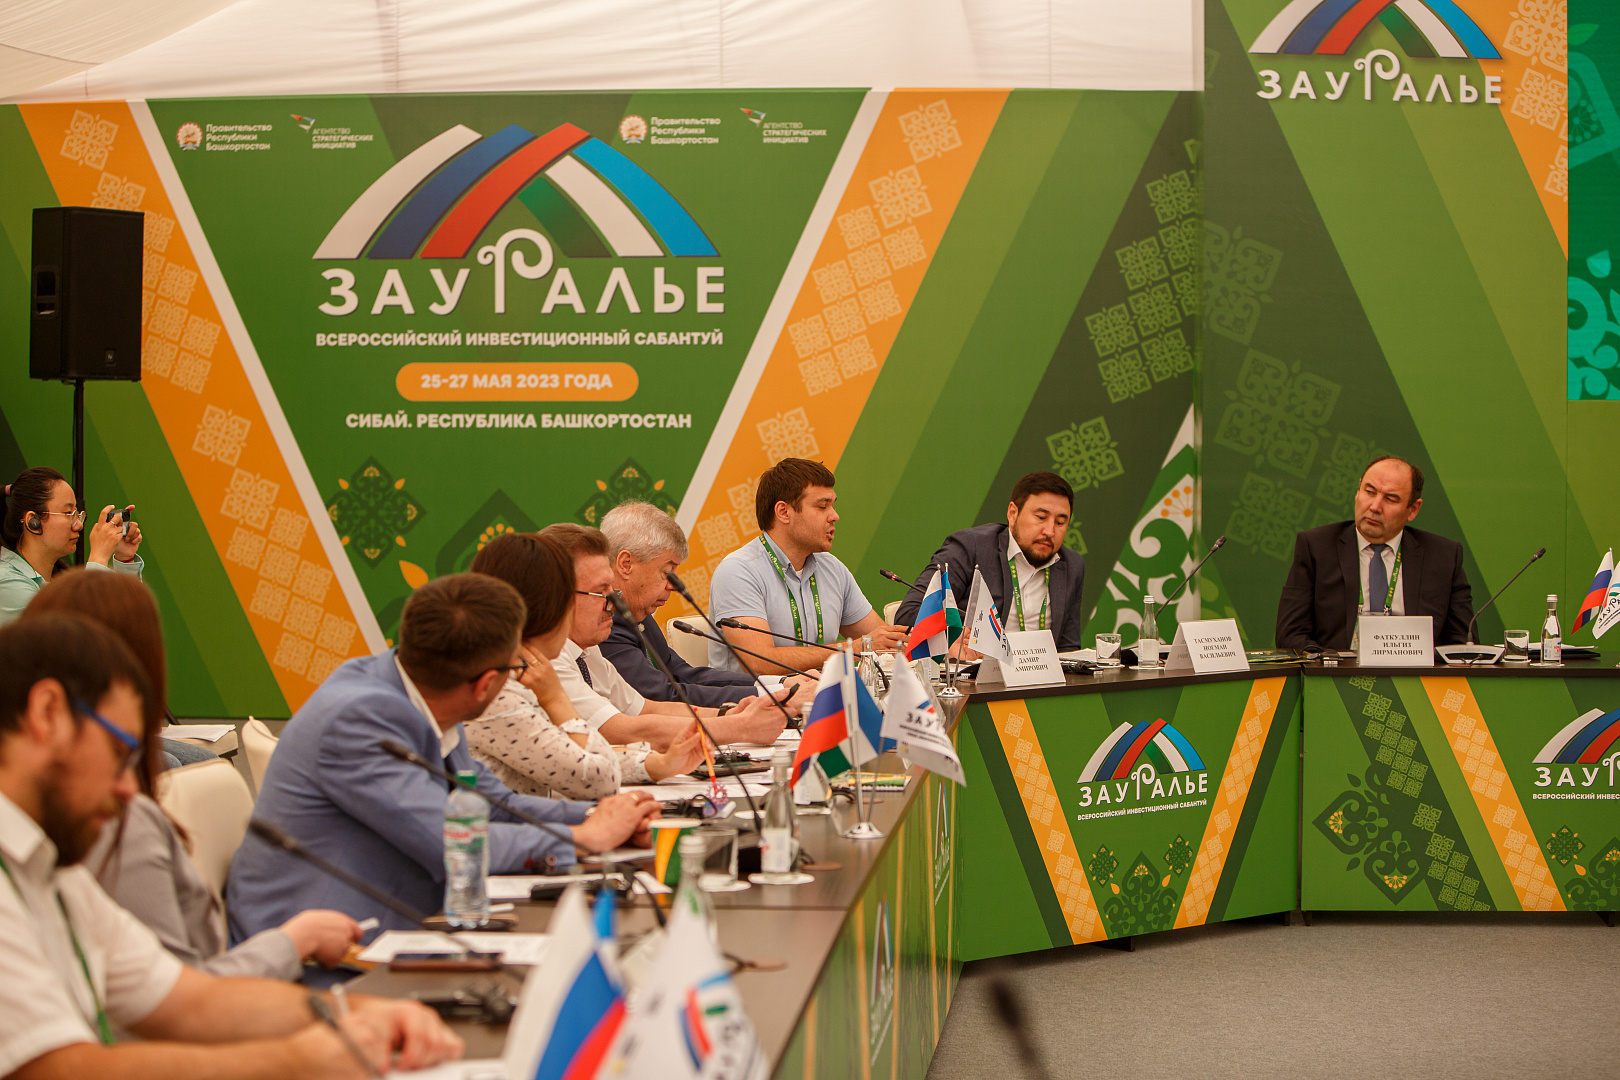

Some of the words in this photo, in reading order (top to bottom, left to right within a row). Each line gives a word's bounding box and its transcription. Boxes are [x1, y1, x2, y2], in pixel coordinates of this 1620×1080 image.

[1256, 48, 1502, 104] ЗАУРАЛЬЕ
[650, 116, 721, 127] Правительство
[205, 123, 272, 134] Правительство
[650, 126, 706, 136] Республики
[762, 129, 827, 137] СТРАТЕГИЧЕСКИХ
[205, 132, 258, 143] Республики
[650, 135, 719, 146] Башкортостан
[205, 141, 271, 152] Башкортостан
[317, 228, 726, 316] ЗАУРАЛЬЕ
[316, 330, 462, 347] ВСЕРОССИЙСКИЙ
[465, 329, 631, 348] ИНВЕСТИЦИОННЫЙ
[634, 329, 724, 346] САБАНТУЙ
[420, 374, 469, 389] 25-27
[472, 374, 512, 388] МАЯ
[516, 374, 560, 388] 2023
[564, 374, 613, 391] ГОДА
[345, 410, 413, 428] СИБАЙ.
[416, 413, 538, 429] РЕСПУБЛИКА
[541, 413, 692, 429] БАШКОРТОСТАН
[1012, 648, 1046, 656] АГИДУЛЛИН
[1200, 651, 1236, 659] ВАСИЛЬЕВИЧ
[1018, 656, 1040, 664] ДАМИР
[1015, 664, 1048, 672] АМИРОВИЧ
[1078, 763, 1208, 807] ЗАУРАЛЬЕ
[1077, 808, 1126, 821] ВСЕРОССИЙСКИЙ
[1126, 802, 1179, 815] ИНВЕСТИЦИОННЫЙ
[1179, 798, 1207, 809] САБАНТУЙ
